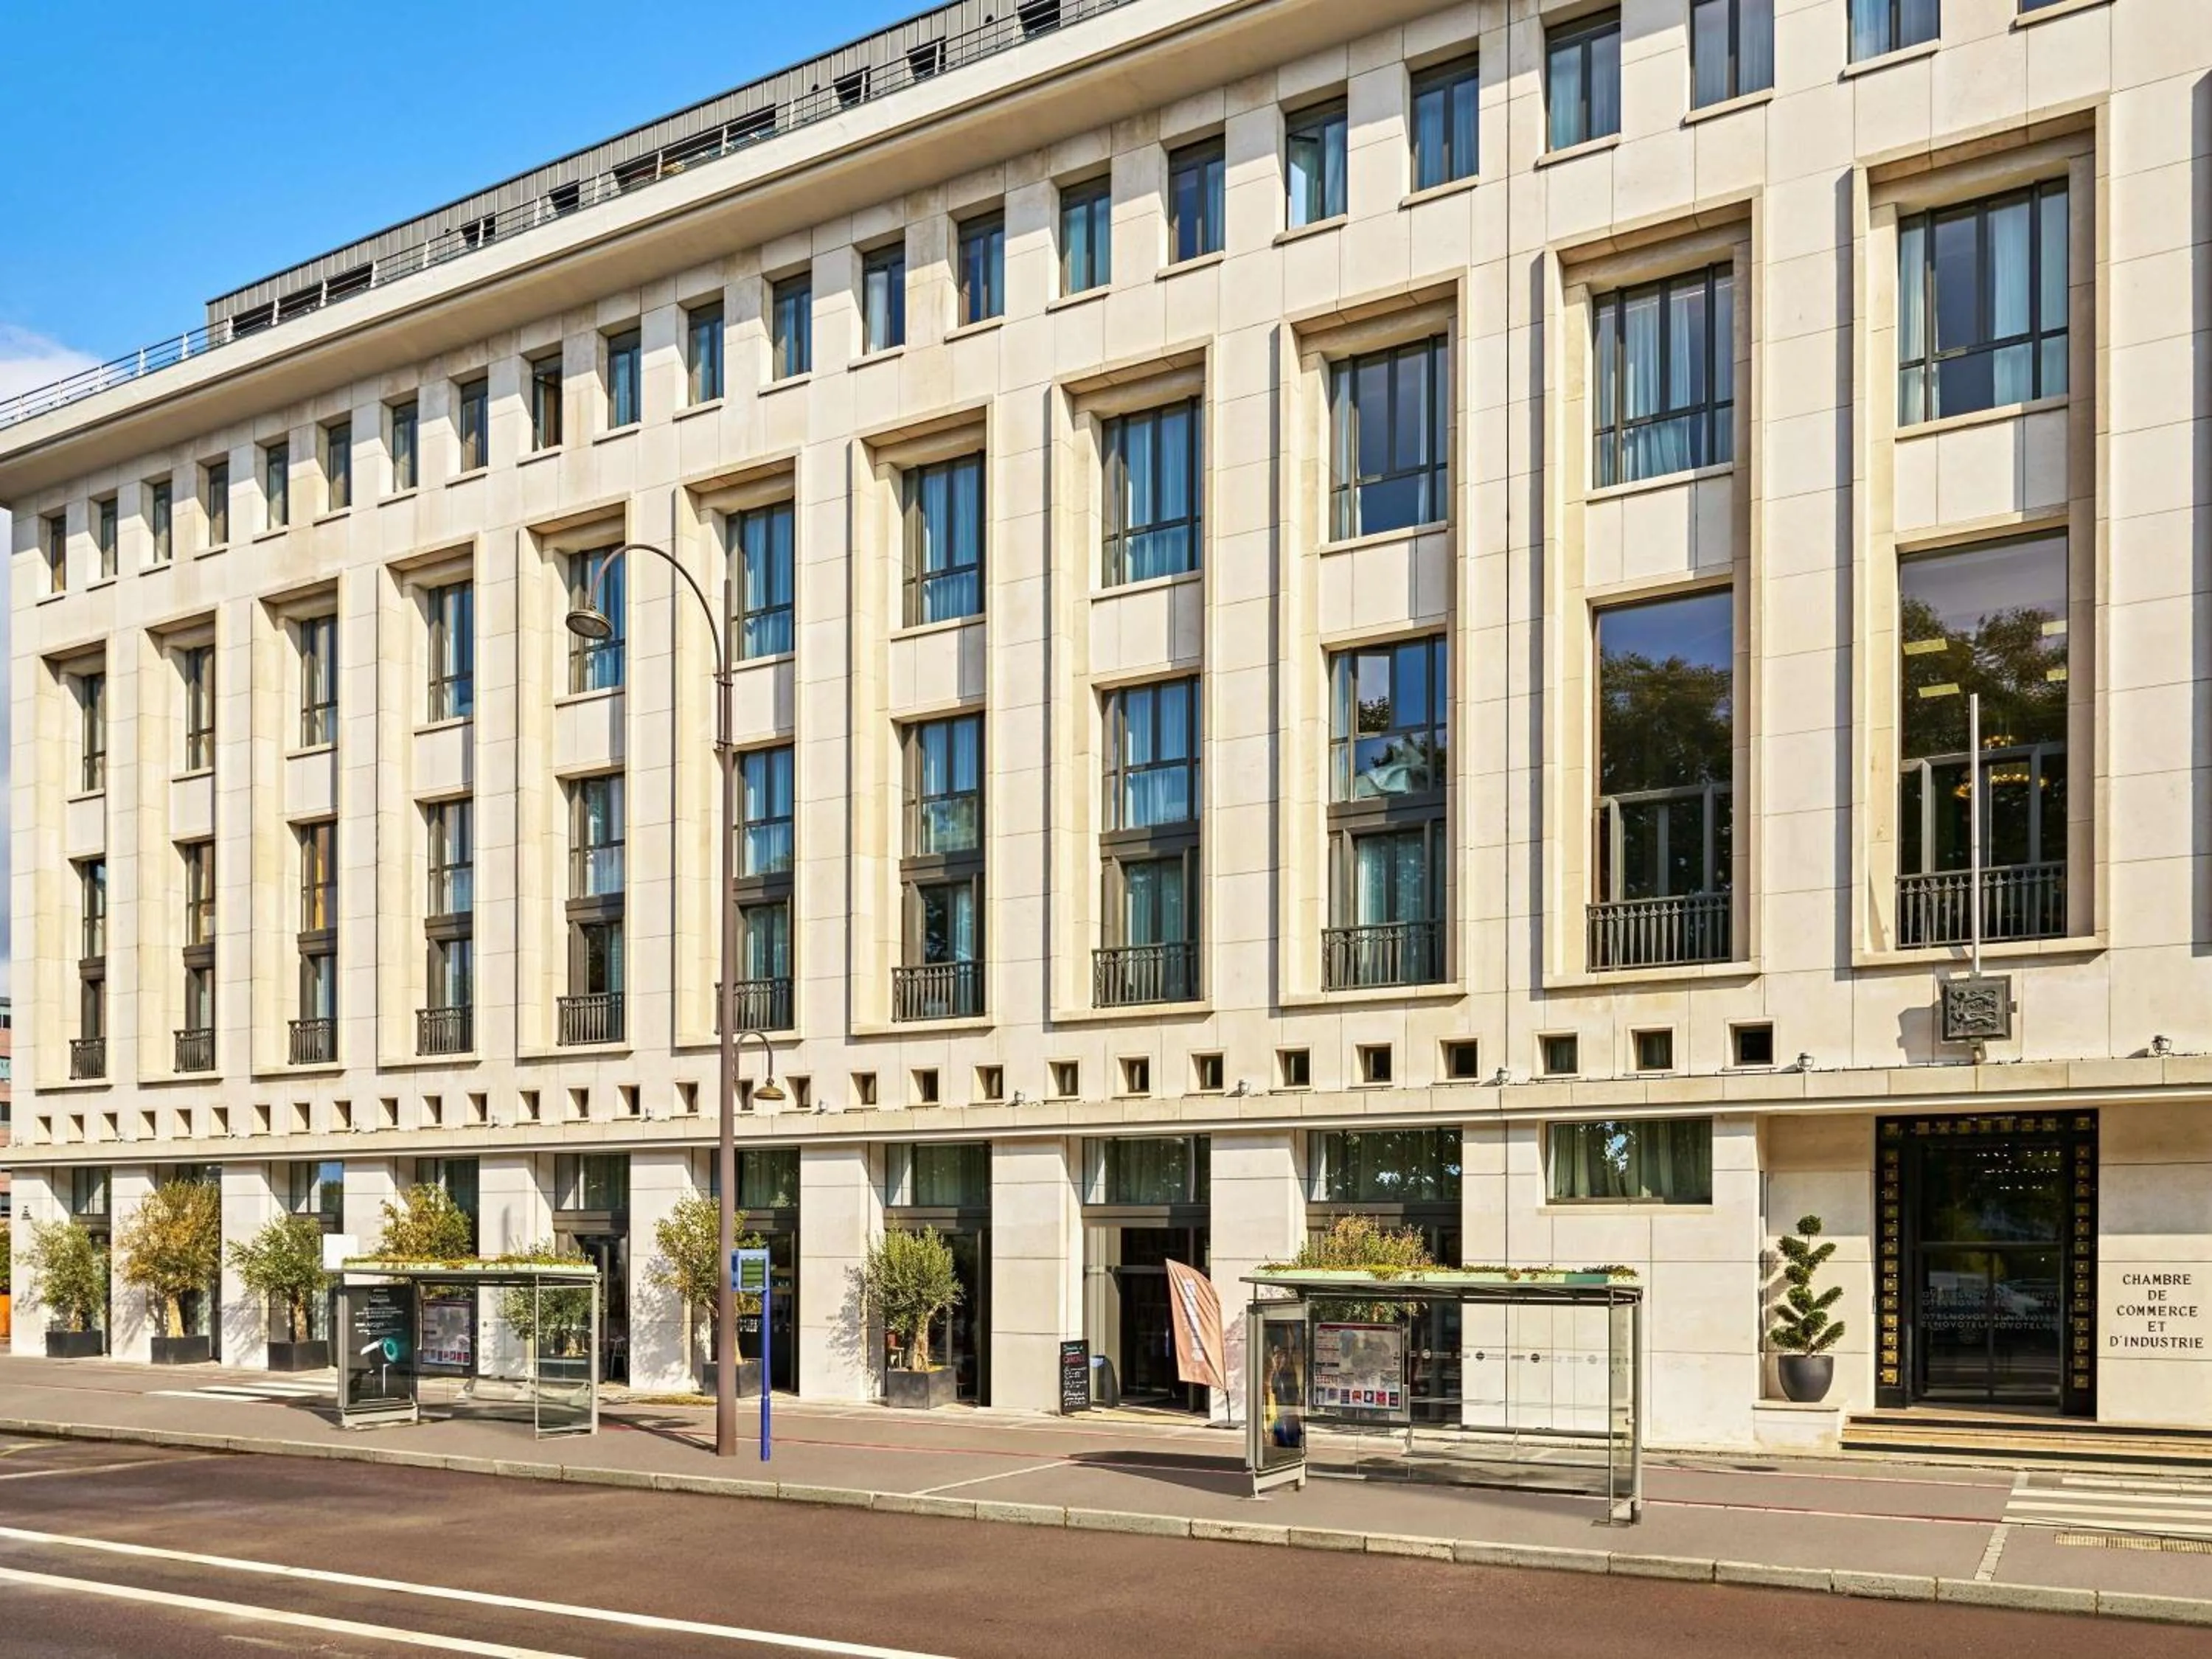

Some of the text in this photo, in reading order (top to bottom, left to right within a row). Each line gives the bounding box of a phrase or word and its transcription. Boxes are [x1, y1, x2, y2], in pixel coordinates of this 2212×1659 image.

[2123, 1274, 2192, 1285] CHAMBRE
[2148, 1290, 2167, 1301] DE
[2117, 1305, 2198, 1317] COMMERCE
[2148, 1321, 2166, 1332] ET
[2110, 1335, 2204, 1349] D'INDUSTRIE
